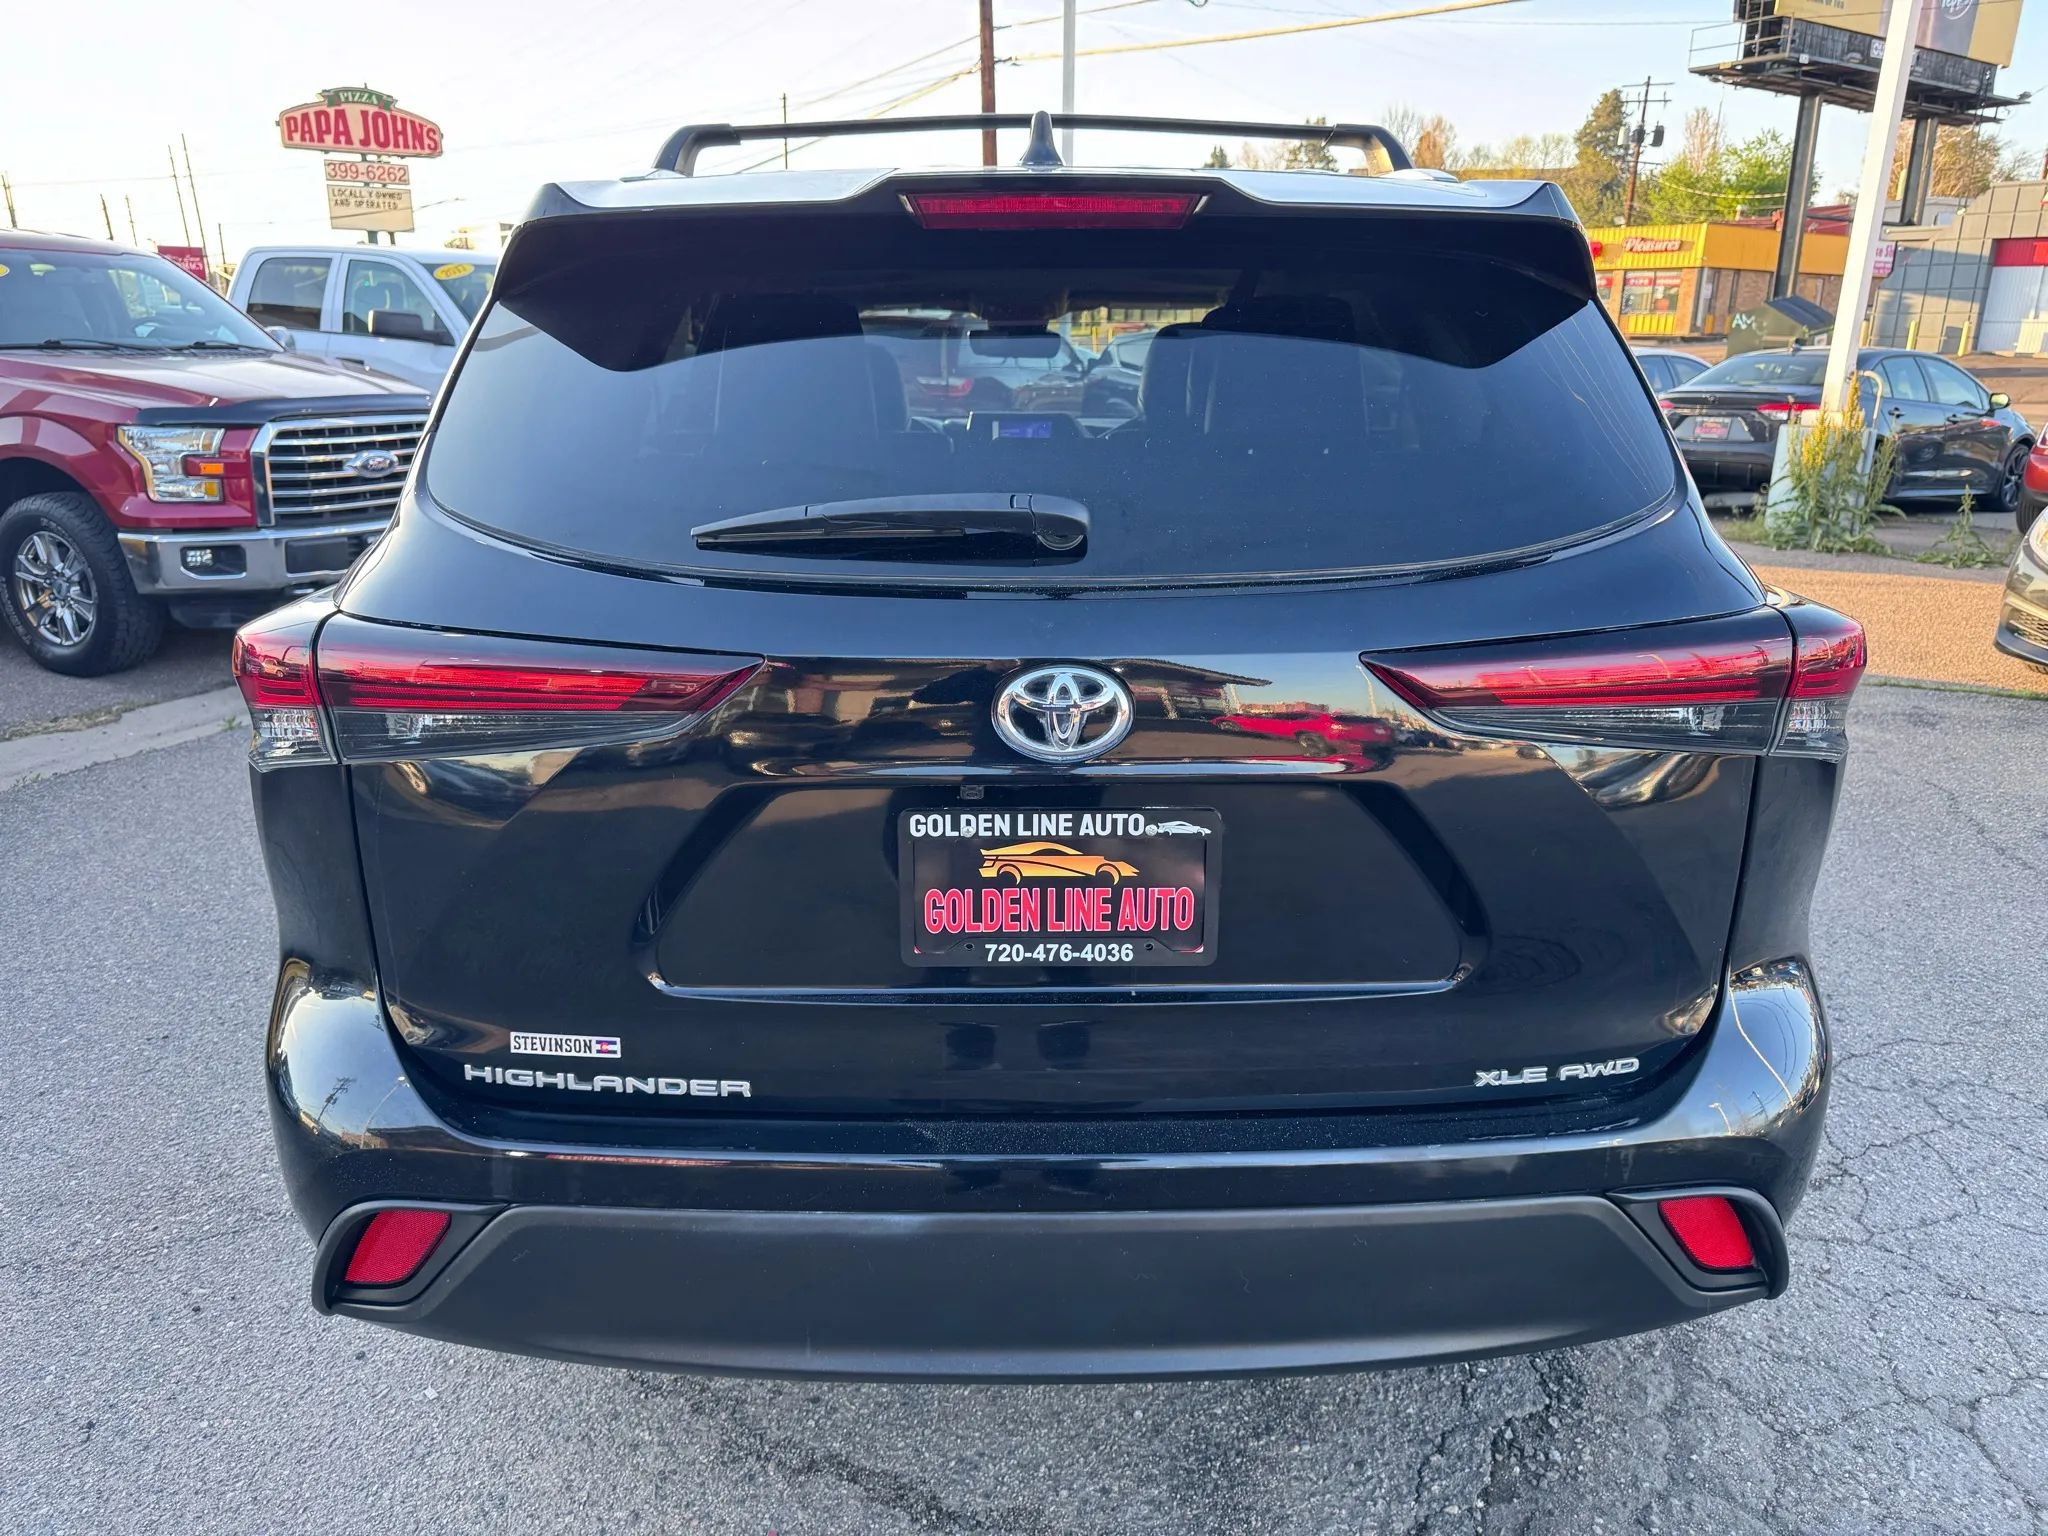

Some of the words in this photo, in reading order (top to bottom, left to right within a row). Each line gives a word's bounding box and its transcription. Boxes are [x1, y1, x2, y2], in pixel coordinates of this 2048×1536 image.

[338, 90, 379, 105] PIZZA
[284, 108, 354, 146] PAPA
[327, 162, 408, 182] 399-6262
[1624, 237, 1682, 253] Pleasures
[909, 813, 1011, 838] GOLDEN
[1017, 813, 1074, 837] LINE
[1079, 812, 1146, 837] AUTO
[924, 888, 1041, 935] GOLDEN
[1047, 887, 1112, 933] LINE
[1117, 886, 1196, 932] AUTO
[984, 943, 1135, 963] 720-476-4036
[513, 1035, 593, 1054] STEVINSON
[463, 1063, 752, 1098] HIGHLANDER
[1474, 1066, 1549, 1087] XLE
[1558, 1056, 1641, 1081] AWD
